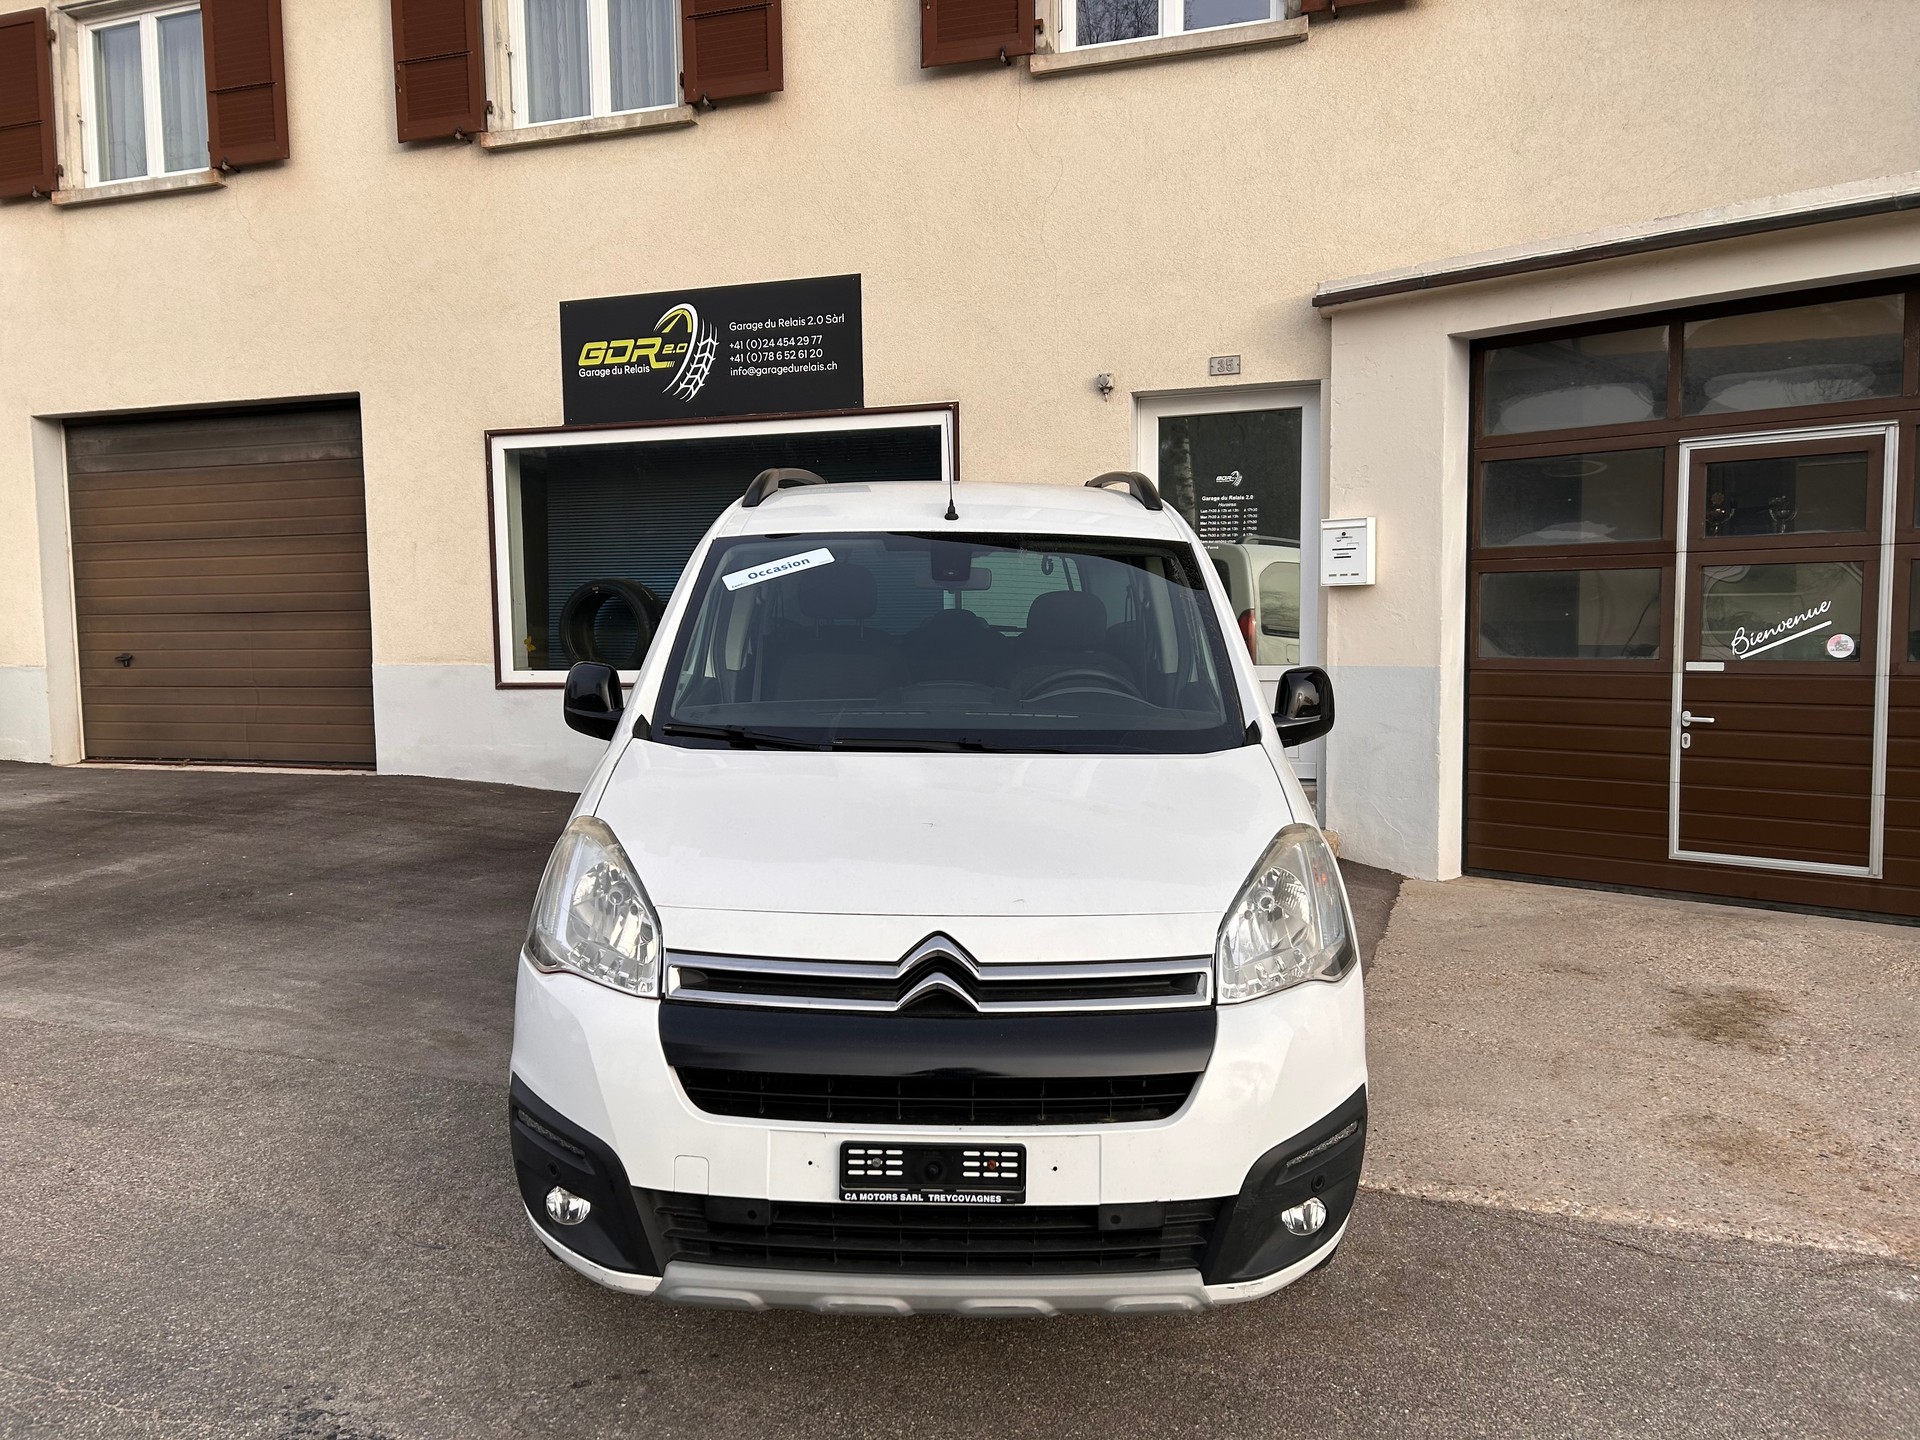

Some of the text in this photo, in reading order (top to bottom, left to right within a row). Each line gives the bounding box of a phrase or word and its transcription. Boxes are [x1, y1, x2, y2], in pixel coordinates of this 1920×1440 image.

[729, 313, 845, 332] Garage du Relais 2.0 Sàrl
[730, 341, 744, 350] +41
[777, 337, 795, 347] 454
[797, 336, 809, 346] 29
[811, 335, 823, 344] 77
[578, 337, 688, 369] GDR 2.0
[730, 354, 744, 363] +41
[798, 350, 807, 359] 61
[809, 348, 823, 358] 20
[578, 364, 650, 378] Garage du Relais
[730, 360, 838, 377] info@garagedurelais.ch
[1217, 358, 1233, 372] 35
[748, 558, 810, 579] Occasion
[1731, 600, 1832, 655] Bienvenue
[844, 1193, 1001, 1203] CA MOTORS SARL TREYCOVAGNES
